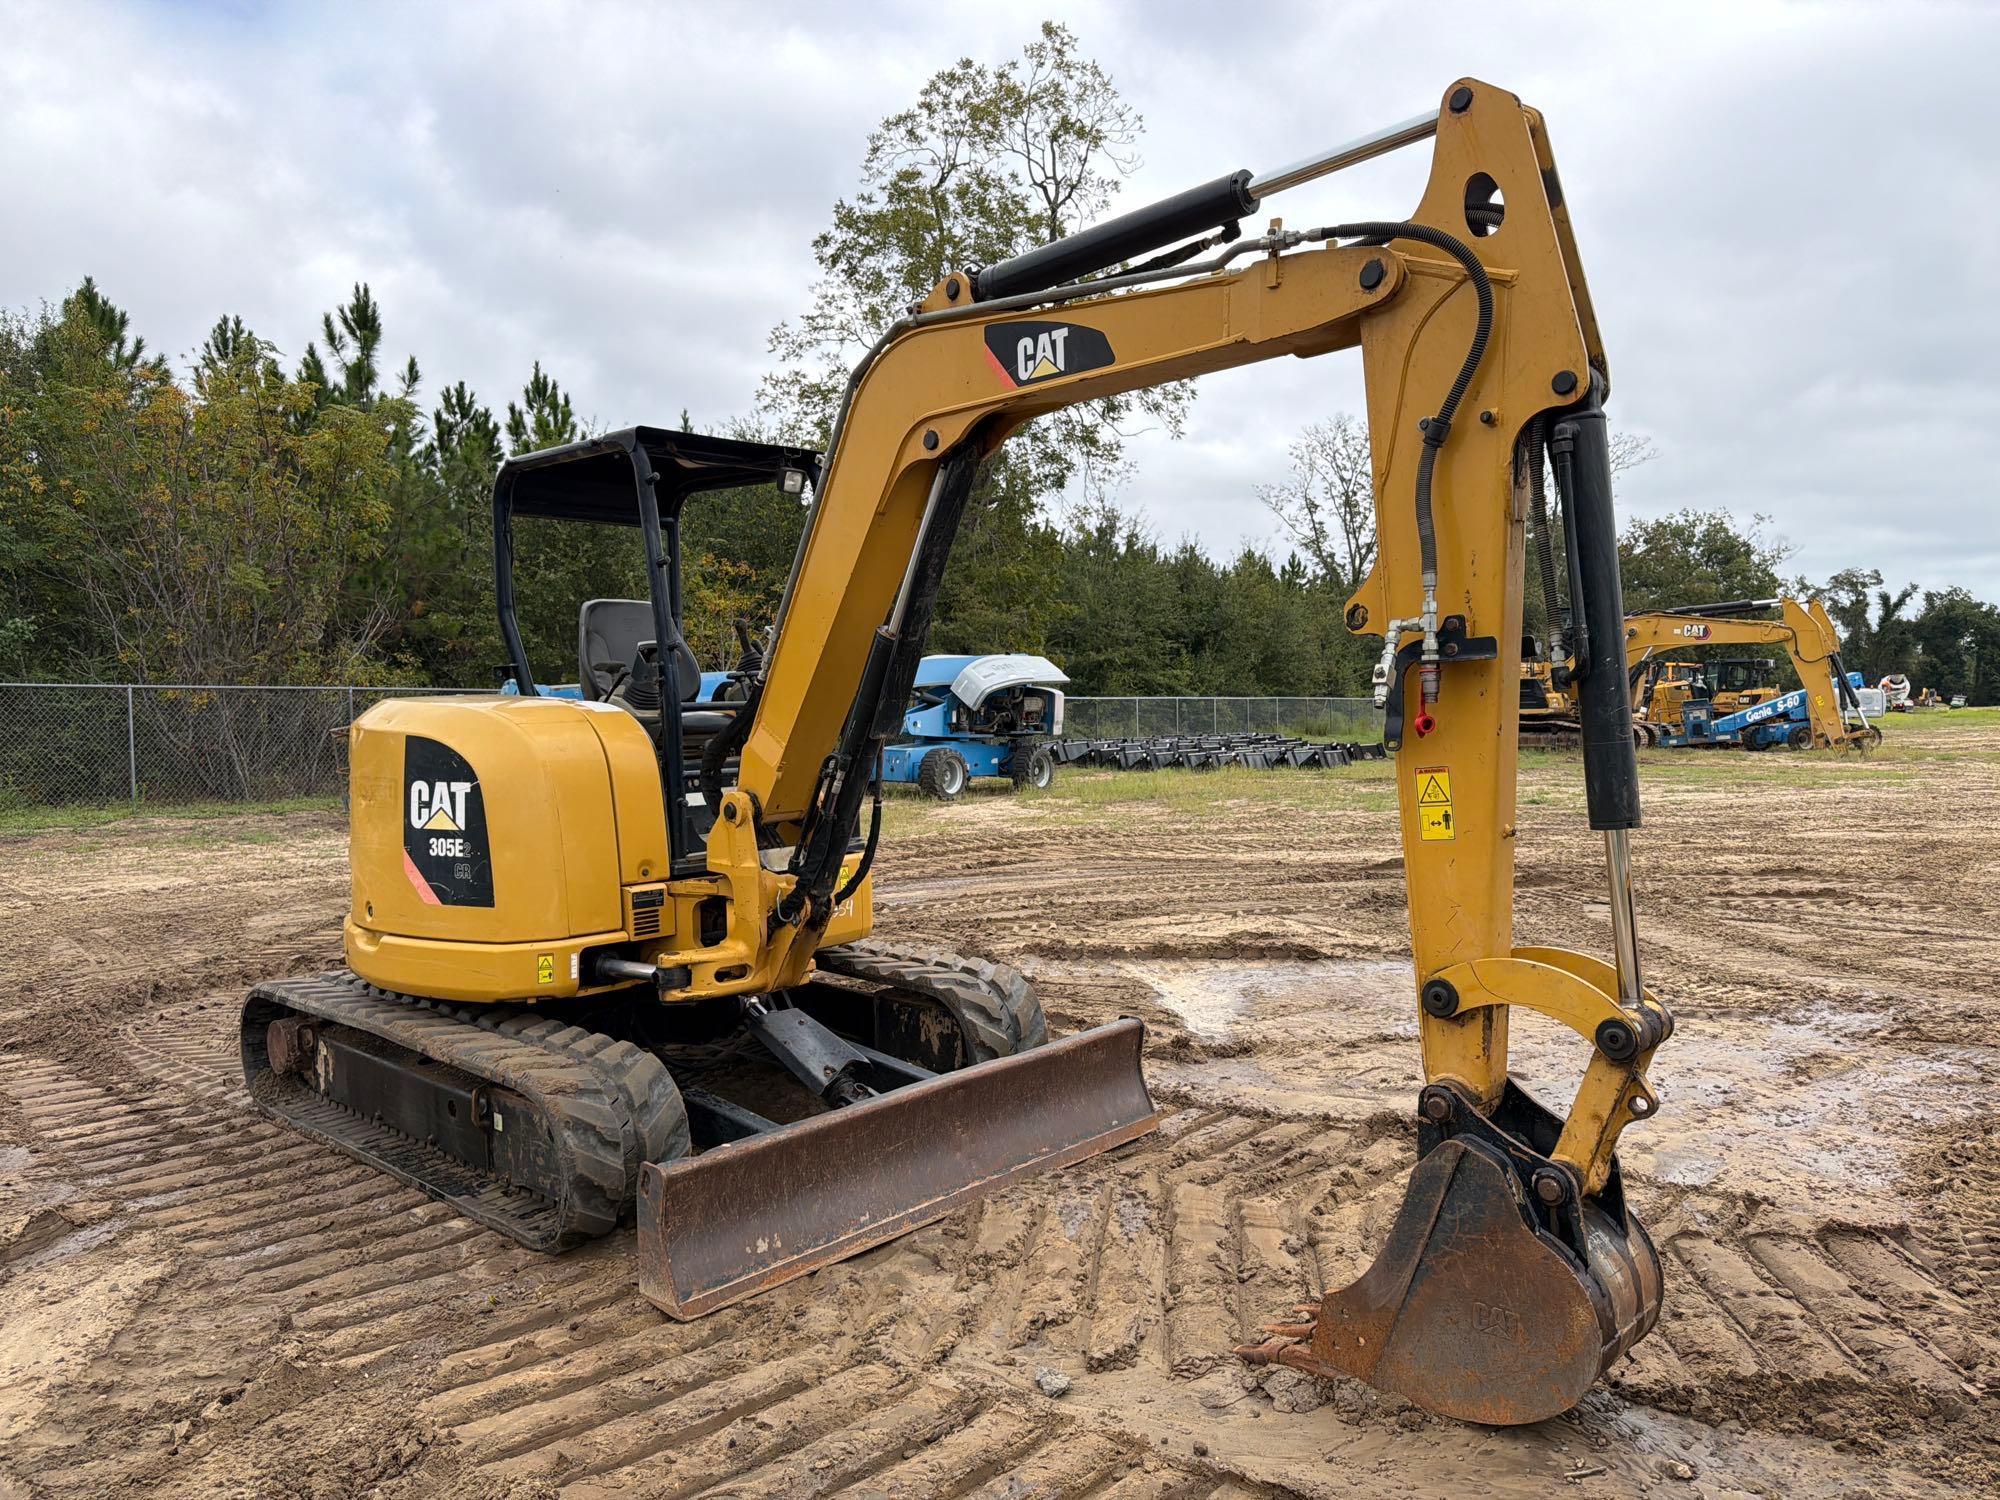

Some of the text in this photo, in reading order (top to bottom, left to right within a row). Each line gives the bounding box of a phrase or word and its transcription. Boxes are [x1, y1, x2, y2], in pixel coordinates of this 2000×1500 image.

[1017, 327, 1069, 381] CAT
[1683, 624, 1706, 637] CAT
[1746, 706, 1773, 722] Genie
[1777, 695, 1800, 711] S-60
[410, 780, 471, 831] CAT
[429, 837, 472, 858] 305E2
[454, 863, 472, 879] CR
[1473, 1302, 1520, 1341] CAT
